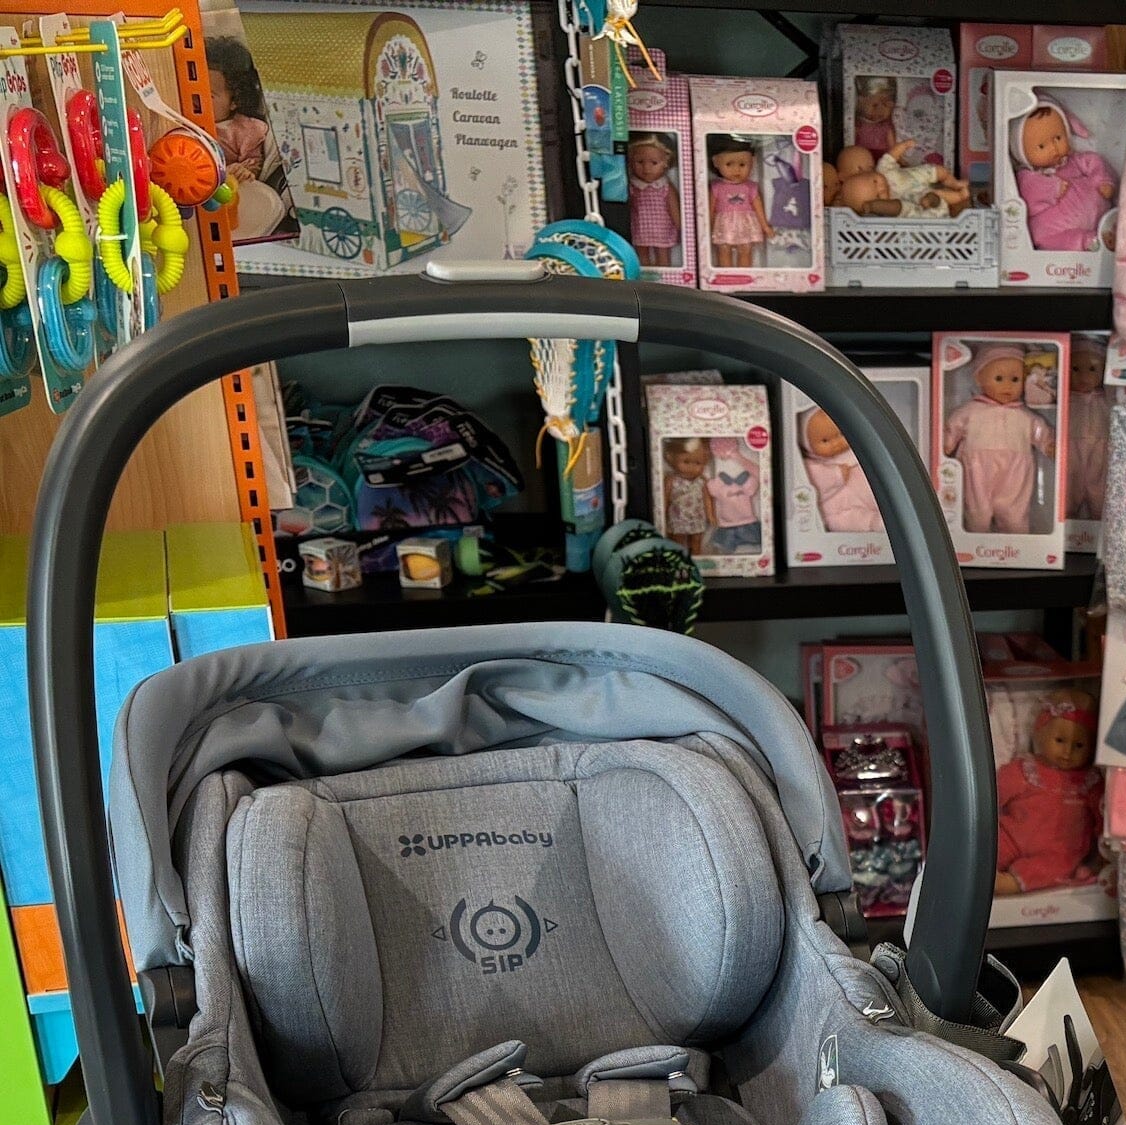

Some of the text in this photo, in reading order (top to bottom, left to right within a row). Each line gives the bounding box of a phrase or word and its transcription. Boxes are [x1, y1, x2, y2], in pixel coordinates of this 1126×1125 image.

[450, 87, 498, 102] Roulotte
[453, 110, 501, 125] Caravan
[455, 133, 518, 151] Planwagen
[427, 829, 553, 851] UPPAbaby
[480, 953, 523, 975] SIP
